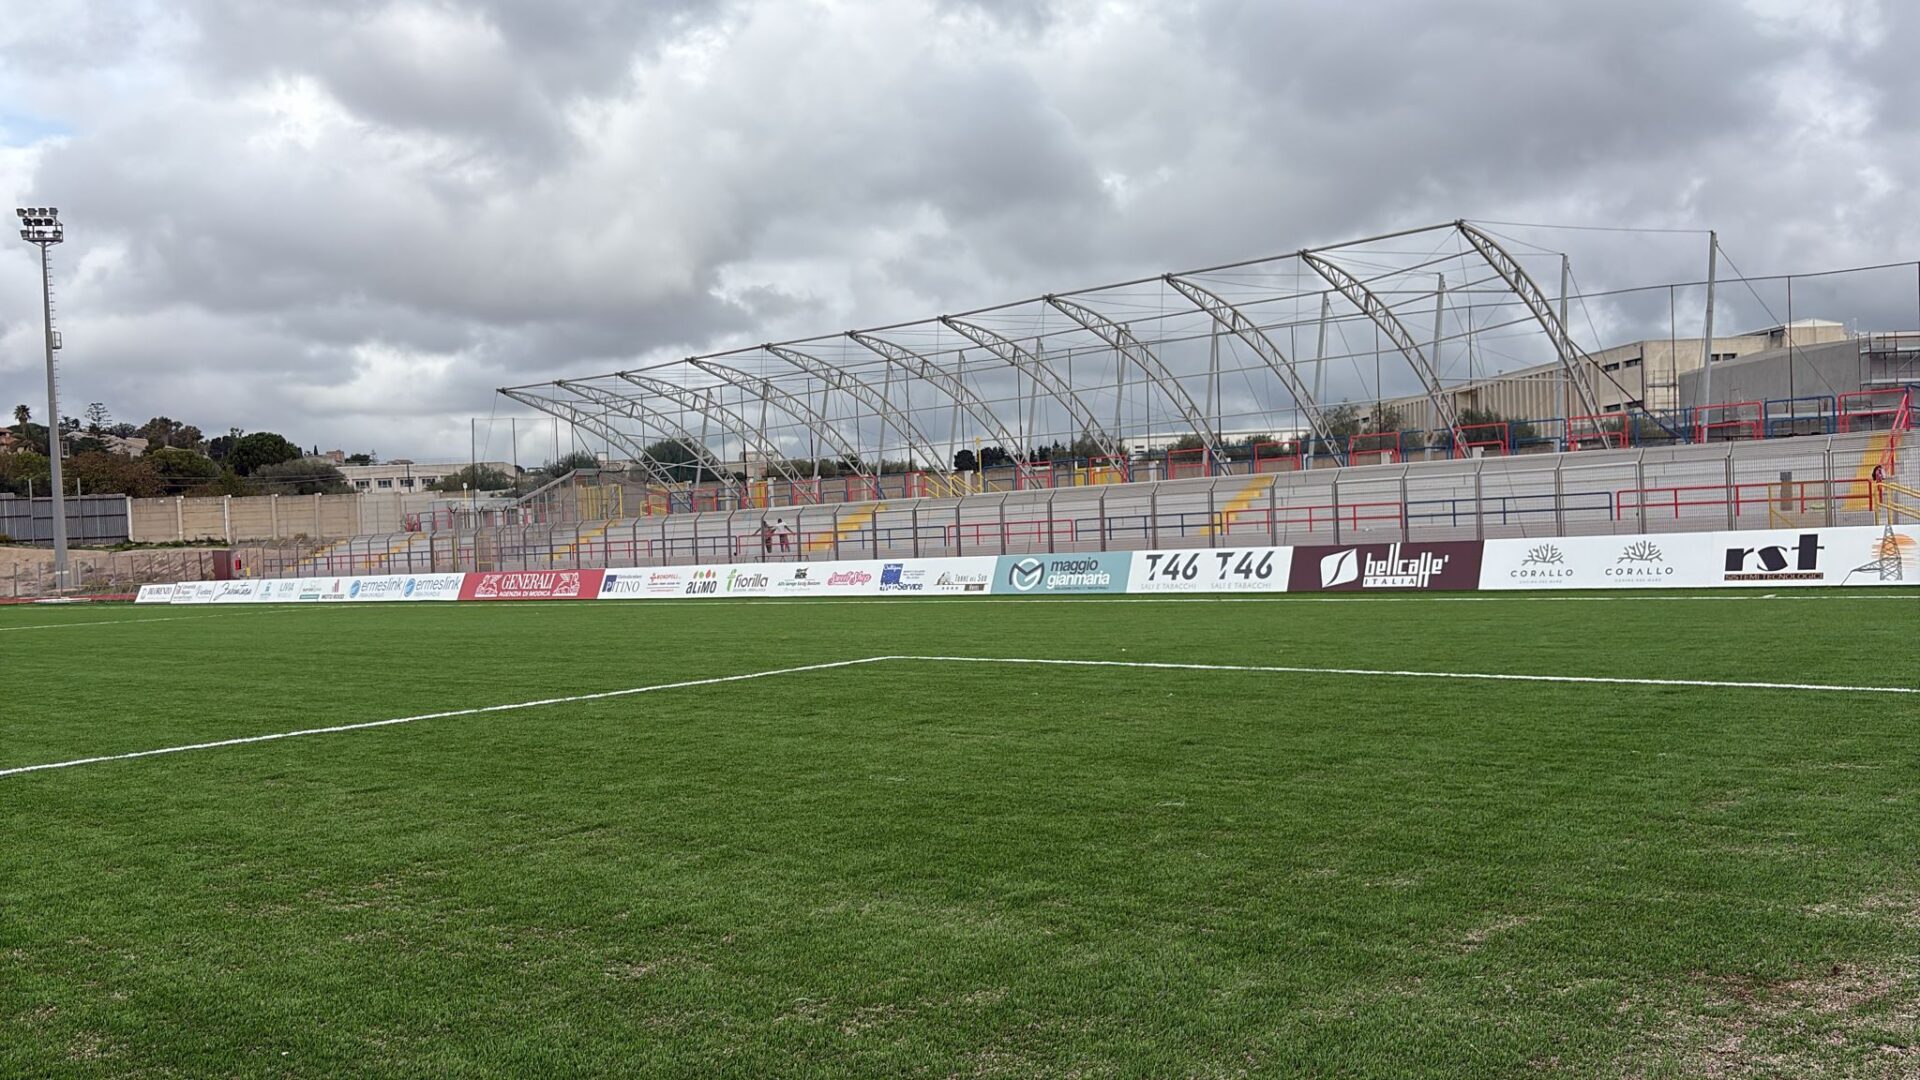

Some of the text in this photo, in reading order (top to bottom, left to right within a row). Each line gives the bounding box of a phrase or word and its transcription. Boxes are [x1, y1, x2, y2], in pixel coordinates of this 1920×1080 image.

[1725, 534, 1825, 571] rst
[1051, 557, 1098, 574] maggio
[1146, 552, 1200, 581] T46
[1216, 551, 1275, 580] T46
[1510, 568, 1574, 578] CORALLO
[1605, 567, 1674, 576] CORALLO
[361, 577, 403, 592] ermeslink
[416, 576, 461, 590] ermeslink
[502, 573, 557, 590] GENERALI
[734, 573, 768, 588] fiorilla
[1047, 571, 1110, 589] gianmaria
[1162, 582, 1197, 590] TABACCHI
[1233, 581, 1272, 589] TABACCHI
[1364, 578, 1416, 586] ITALIA
